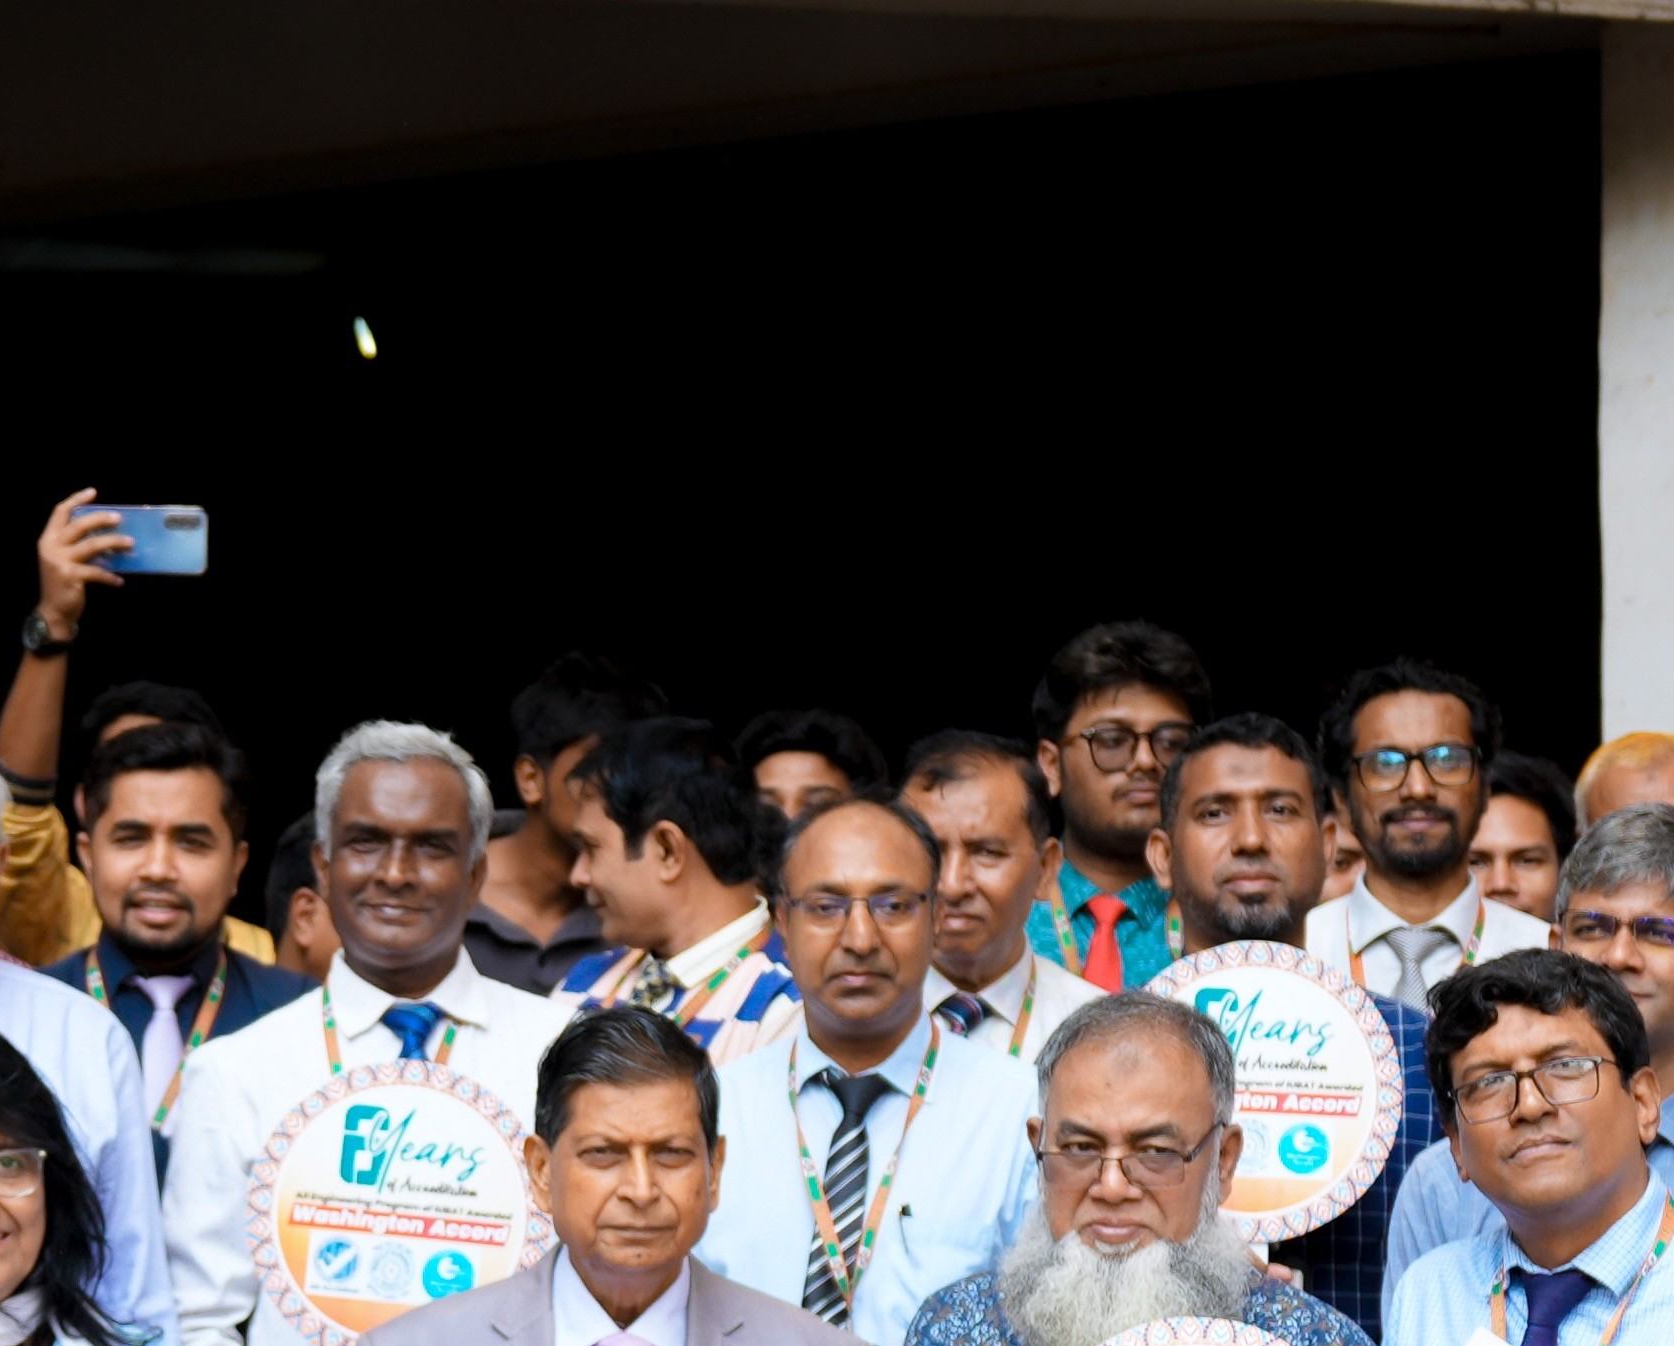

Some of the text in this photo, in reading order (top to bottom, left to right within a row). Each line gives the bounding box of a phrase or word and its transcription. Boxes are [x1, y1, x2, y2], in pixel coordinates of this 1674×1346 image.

[1282, 1093, 1360, 1112] Accord
[369, 1108, 484, 1195] Years
[293, 1203, 509, 1244] Washington Accord
